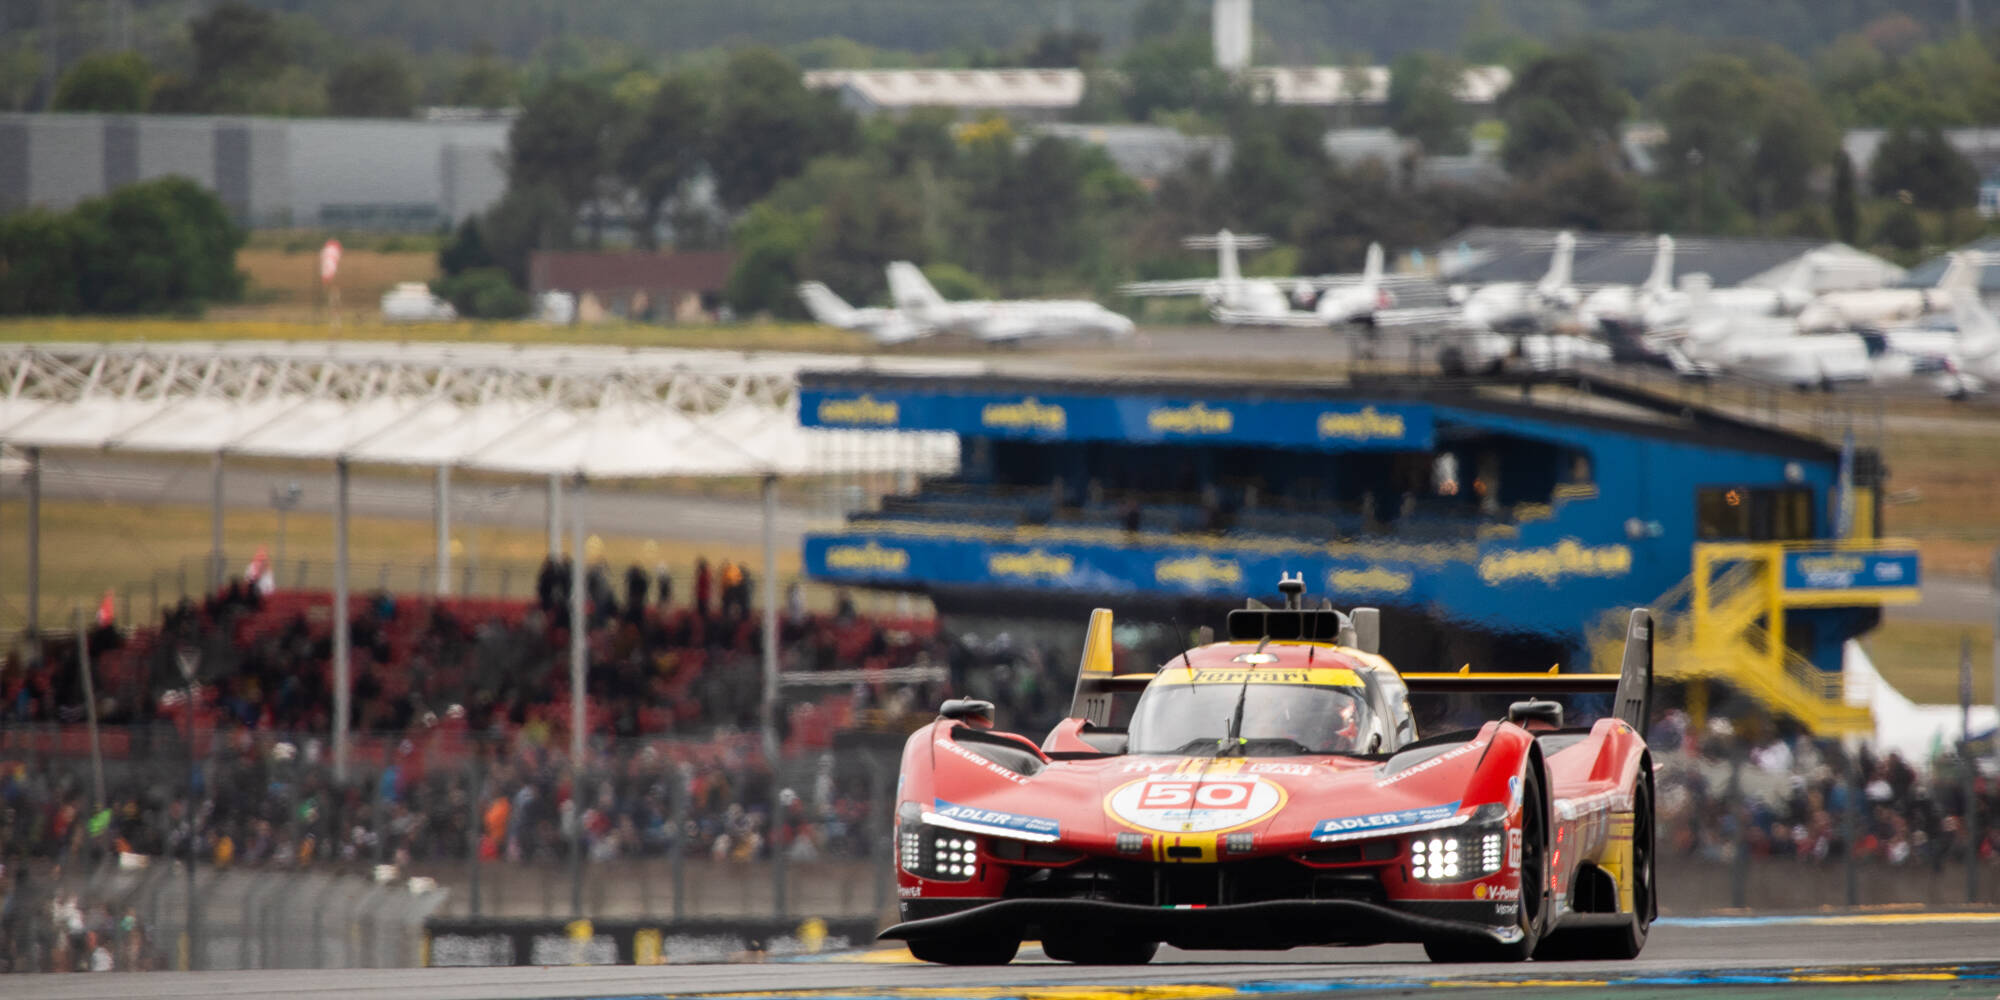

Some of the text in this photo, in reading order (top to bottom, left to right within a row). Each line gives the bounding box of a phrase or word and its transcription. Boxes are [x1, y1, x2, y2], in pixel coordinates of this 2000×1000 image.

[1192, 668, 1311, 682] Ferrari
[1144, 784, 1247, 806] 50
[940, 806, 1011, 824] ADLER
[1323, 814, 1399, 832] ADLER
